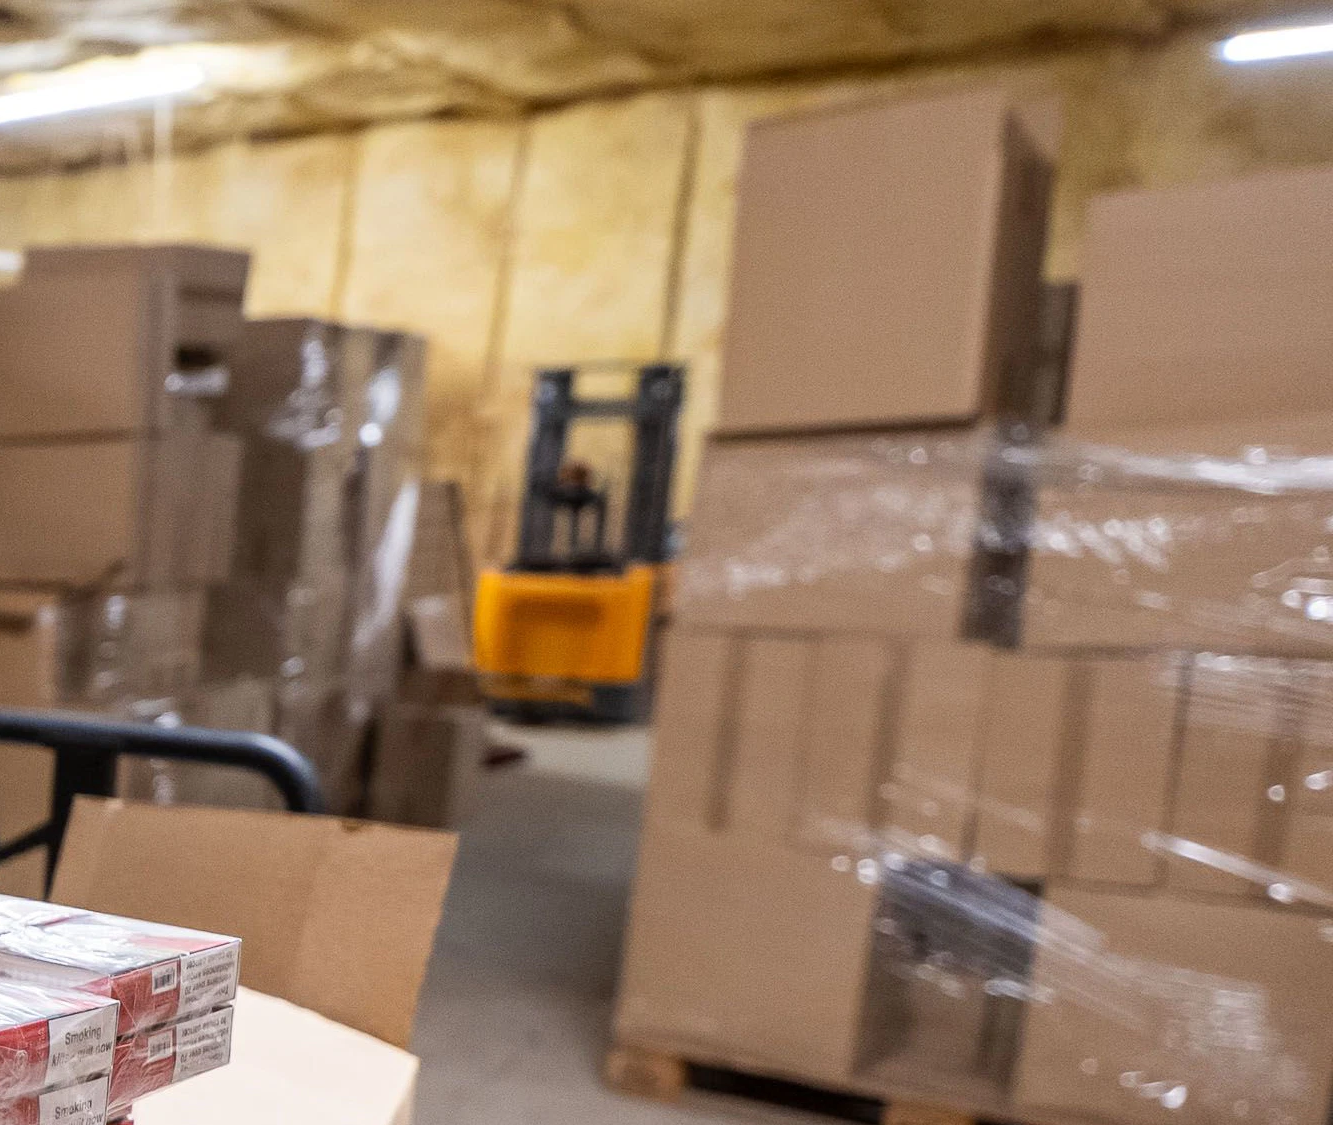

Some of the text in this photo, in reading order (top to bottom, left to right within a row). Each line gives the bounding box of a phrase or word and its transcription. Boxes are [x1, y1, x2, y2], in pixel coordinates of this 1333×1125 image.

[65, 1025, 101, 1045] Smoking
[95, 1044, 112, 1055] now
[54, 1098, 93, 1119] Smoking
